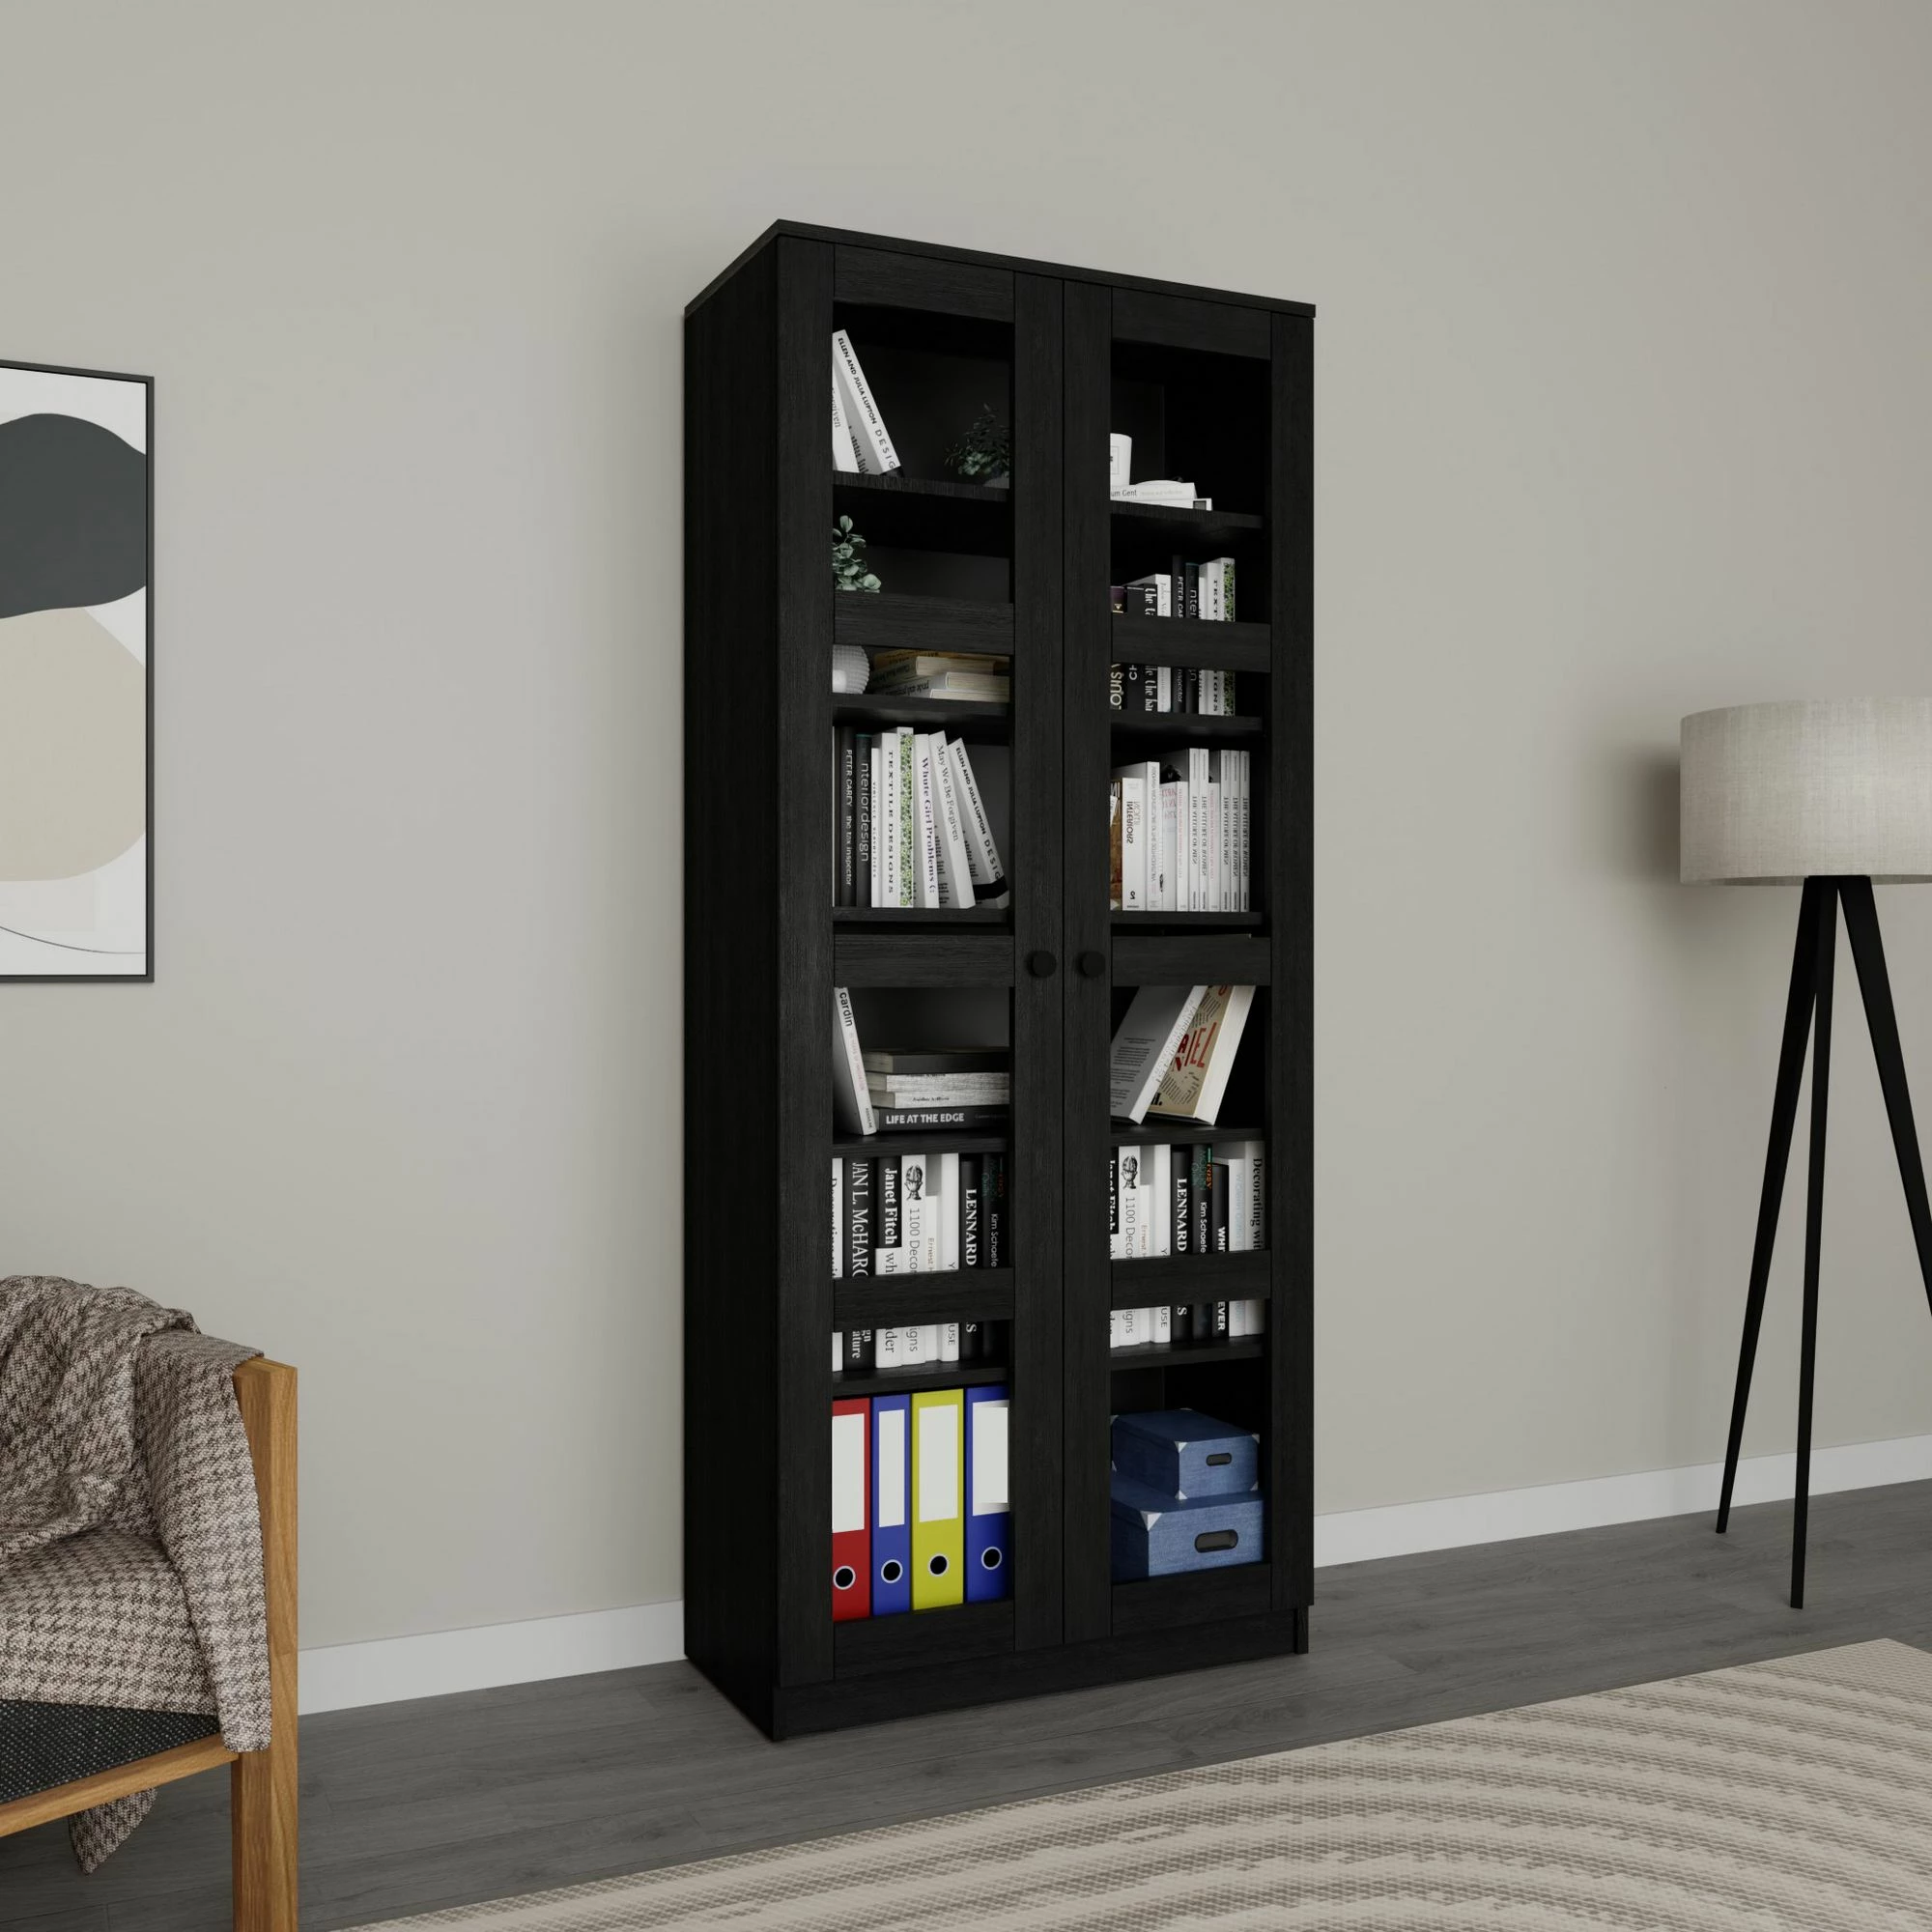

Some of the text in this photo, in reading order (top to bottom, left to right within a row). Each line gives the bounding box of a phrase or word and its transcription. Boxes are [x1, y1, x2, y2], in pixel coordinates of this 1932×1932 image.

[838, 337, 850, 358] ELLEN
[847, 358, 857, 375] AND
[854, 377, 866, 396] JULIA
[863, 396, 878, 425] LUPTON
[923, 799, 932, 824] Girl
[936, 745, 959, 841] May We Be Forgiven
[955, 746, 965, 768] ELLEN
[962, 768, 971, 785] AND
[968, 786, 979, 806] JULIA
[974, 806, 987, 835] LUPTON
[844, 847, 853, 886] inspector
[923, 826, 936, 883] Problems
[838, 992, 853, 1027] cardin
[886, 1115, 905, 1124] LIFE
[906, 1114, 919, 1123] AT
[920, 1114, 938, 1123] THE
[940, 1113, 965, 1122] EDGE
[852, 1190, 868, 1205] L.
[885, 1168, 897, 1244] Janet Fitch
[909, 1208, 920, 1236] 1100
[1125, 1197, 1135, 1224] 1100
[1177, 1178, 1187, 1251] LENNARD
[1250, 1158, 1263, 1250] Decorating wit
[966, 1188, 977, 1265] LENNARD
